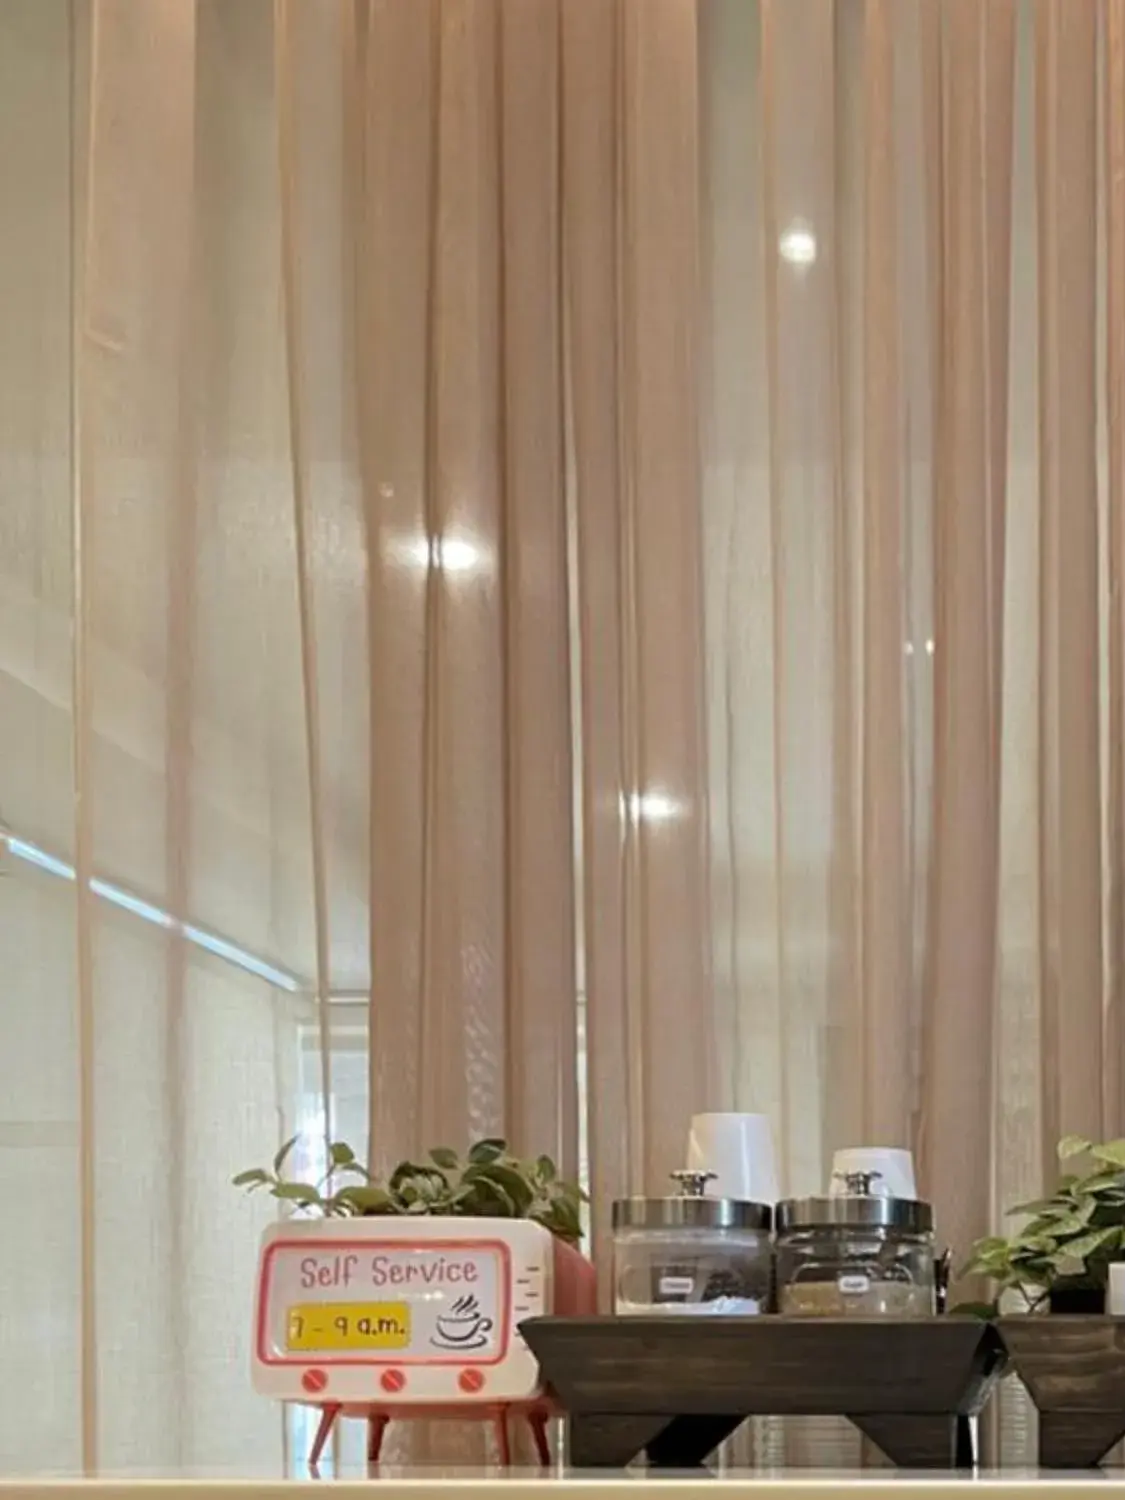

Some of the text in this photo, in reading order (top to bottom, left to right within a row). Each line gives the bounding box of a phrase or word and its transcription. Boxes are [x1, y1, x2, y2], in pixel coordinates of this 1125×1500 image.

[300, 1254, 479, 1289] Self Service
[292, 1316, 304, 1339] 7
[334, 1316, 348, 1337] 9
[357, 1316, 406, 1336] a.m.
